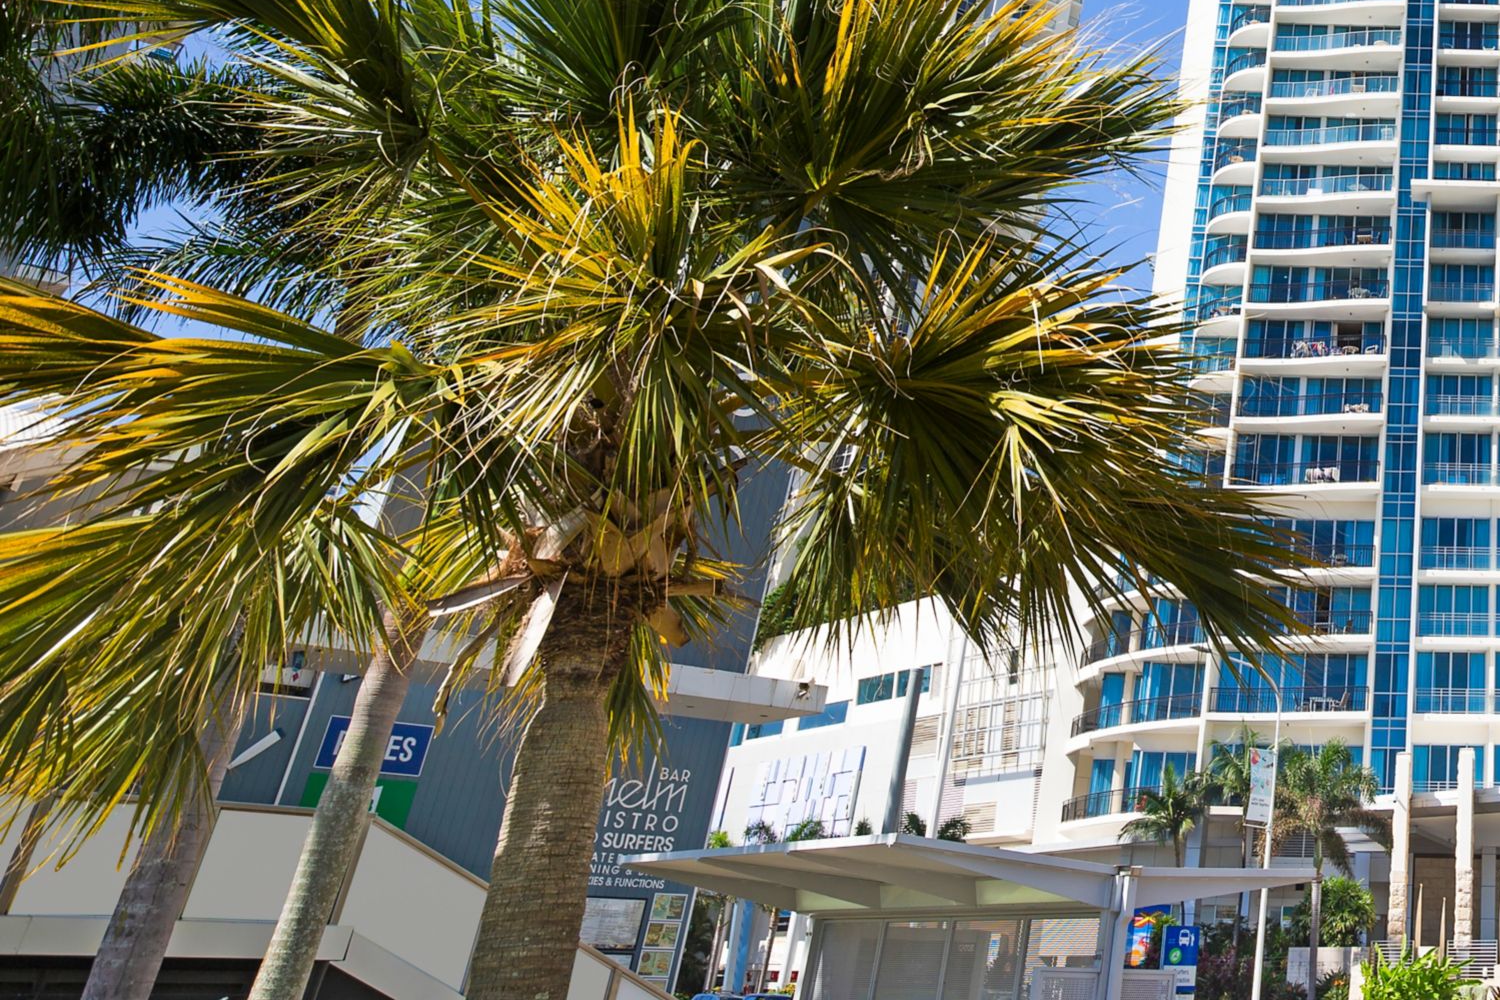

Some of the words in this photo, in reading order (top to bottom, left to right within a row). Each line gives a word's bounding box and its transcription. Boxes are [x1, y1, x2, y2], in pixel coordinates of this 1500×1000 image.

[660, 767, 691, 782] BAR
[603, 810, 679, 833] ISTRO
[602, 832, 675, 851] SURFERS
[614, 878, 665, 890] FUNCTIONS
